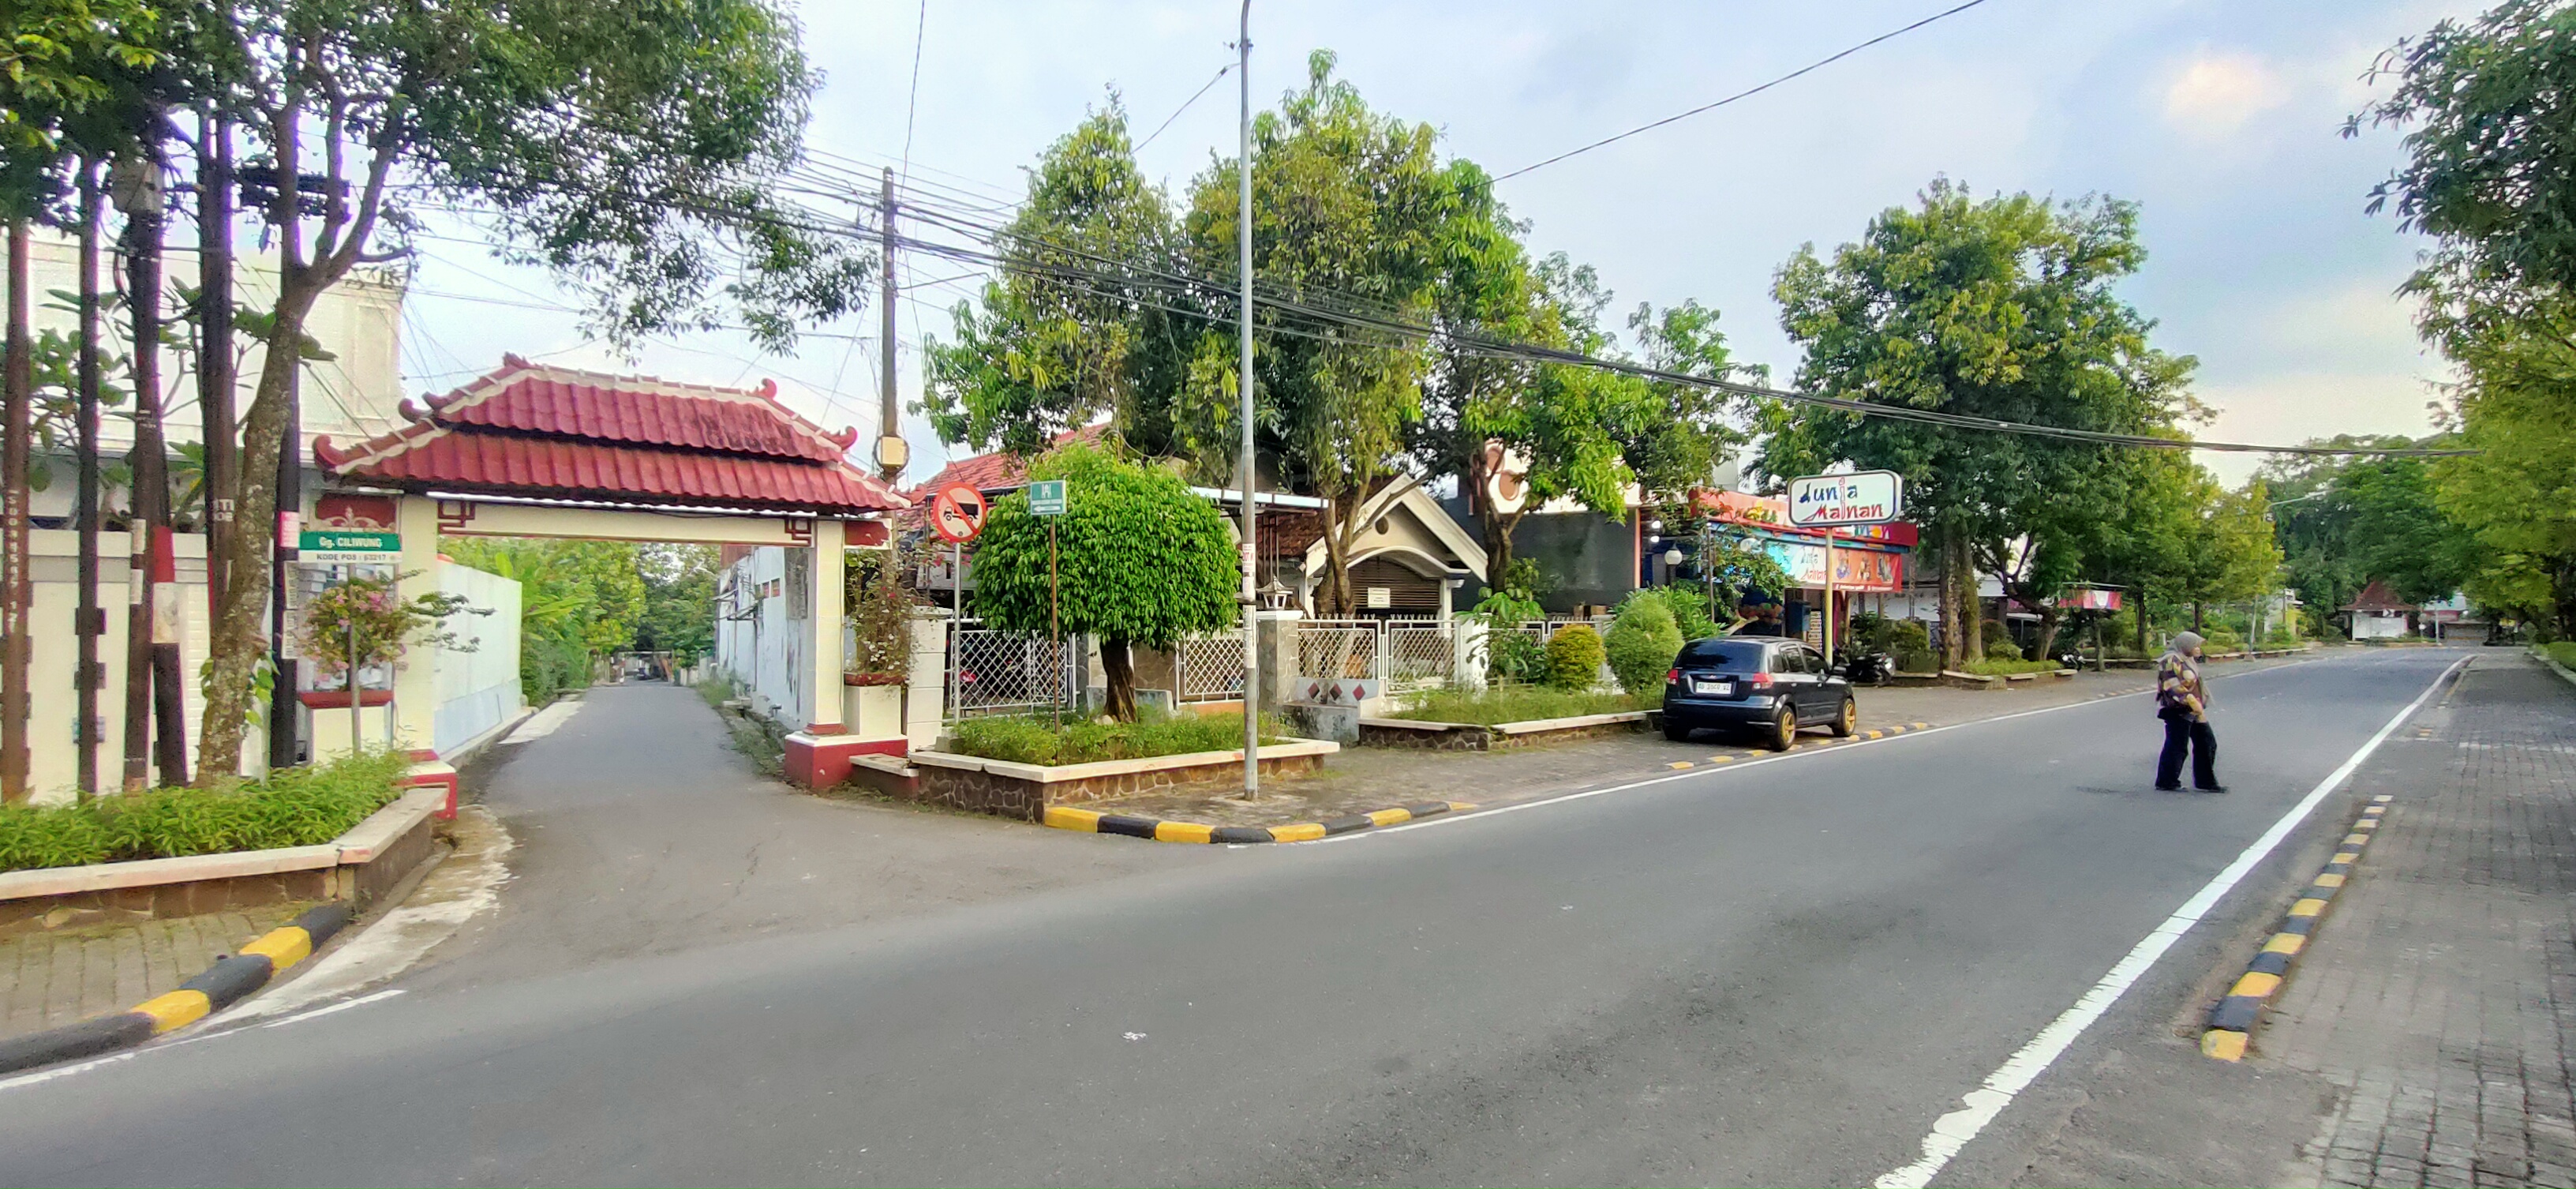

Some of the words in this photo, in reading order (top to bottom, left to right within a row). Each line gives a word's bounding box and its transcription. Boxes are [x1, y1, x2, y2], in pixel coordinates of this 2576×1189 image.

[1799, 477, 1858, 503] dunia
[1801, 502, 1884, 521] Mainan
[337, 537, 383, 548] CILIWUNG
